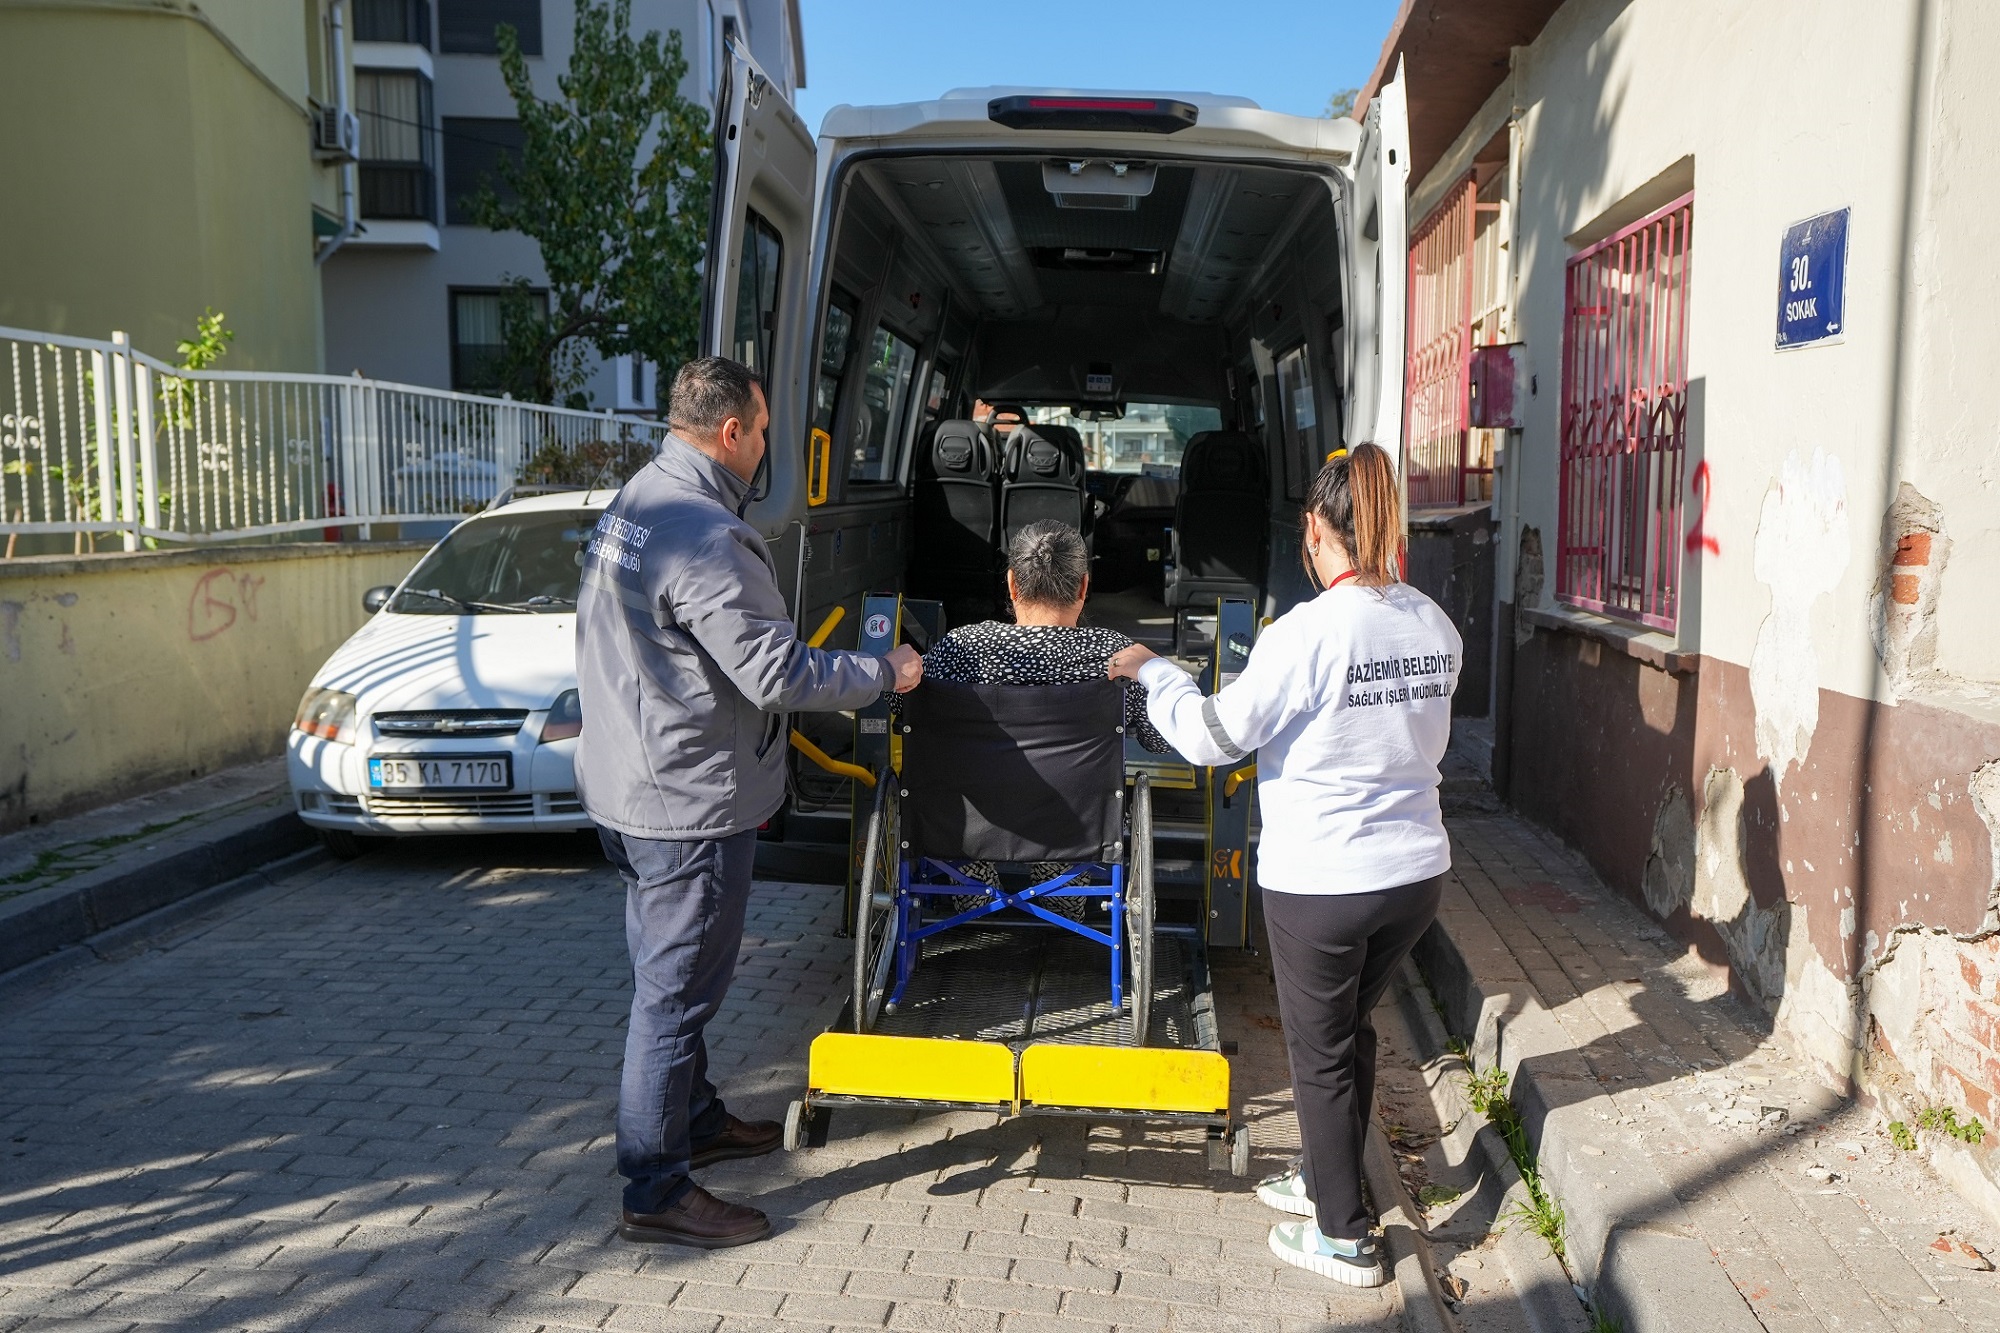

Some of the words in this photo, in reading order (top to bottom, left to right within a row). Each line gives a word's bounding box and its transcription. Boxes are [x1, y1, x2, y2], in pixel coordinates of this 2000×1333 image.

[1790, 255, 1811, 293] 30.
[1786, 298, 1817, 322] SOKAK
[1346, 655, 1402, 685] GAZİEMİR
[1402, 650, 1456, 677] BELEDİYE
[1348, 691, 1383, 708] SAĞLIK
[1385, 685, 1410, 707] İŞLERİ
[383, 762, 408, 784] 35
[418, 762, 443, 784] KA
[451, 762, 501, 784] 7170
